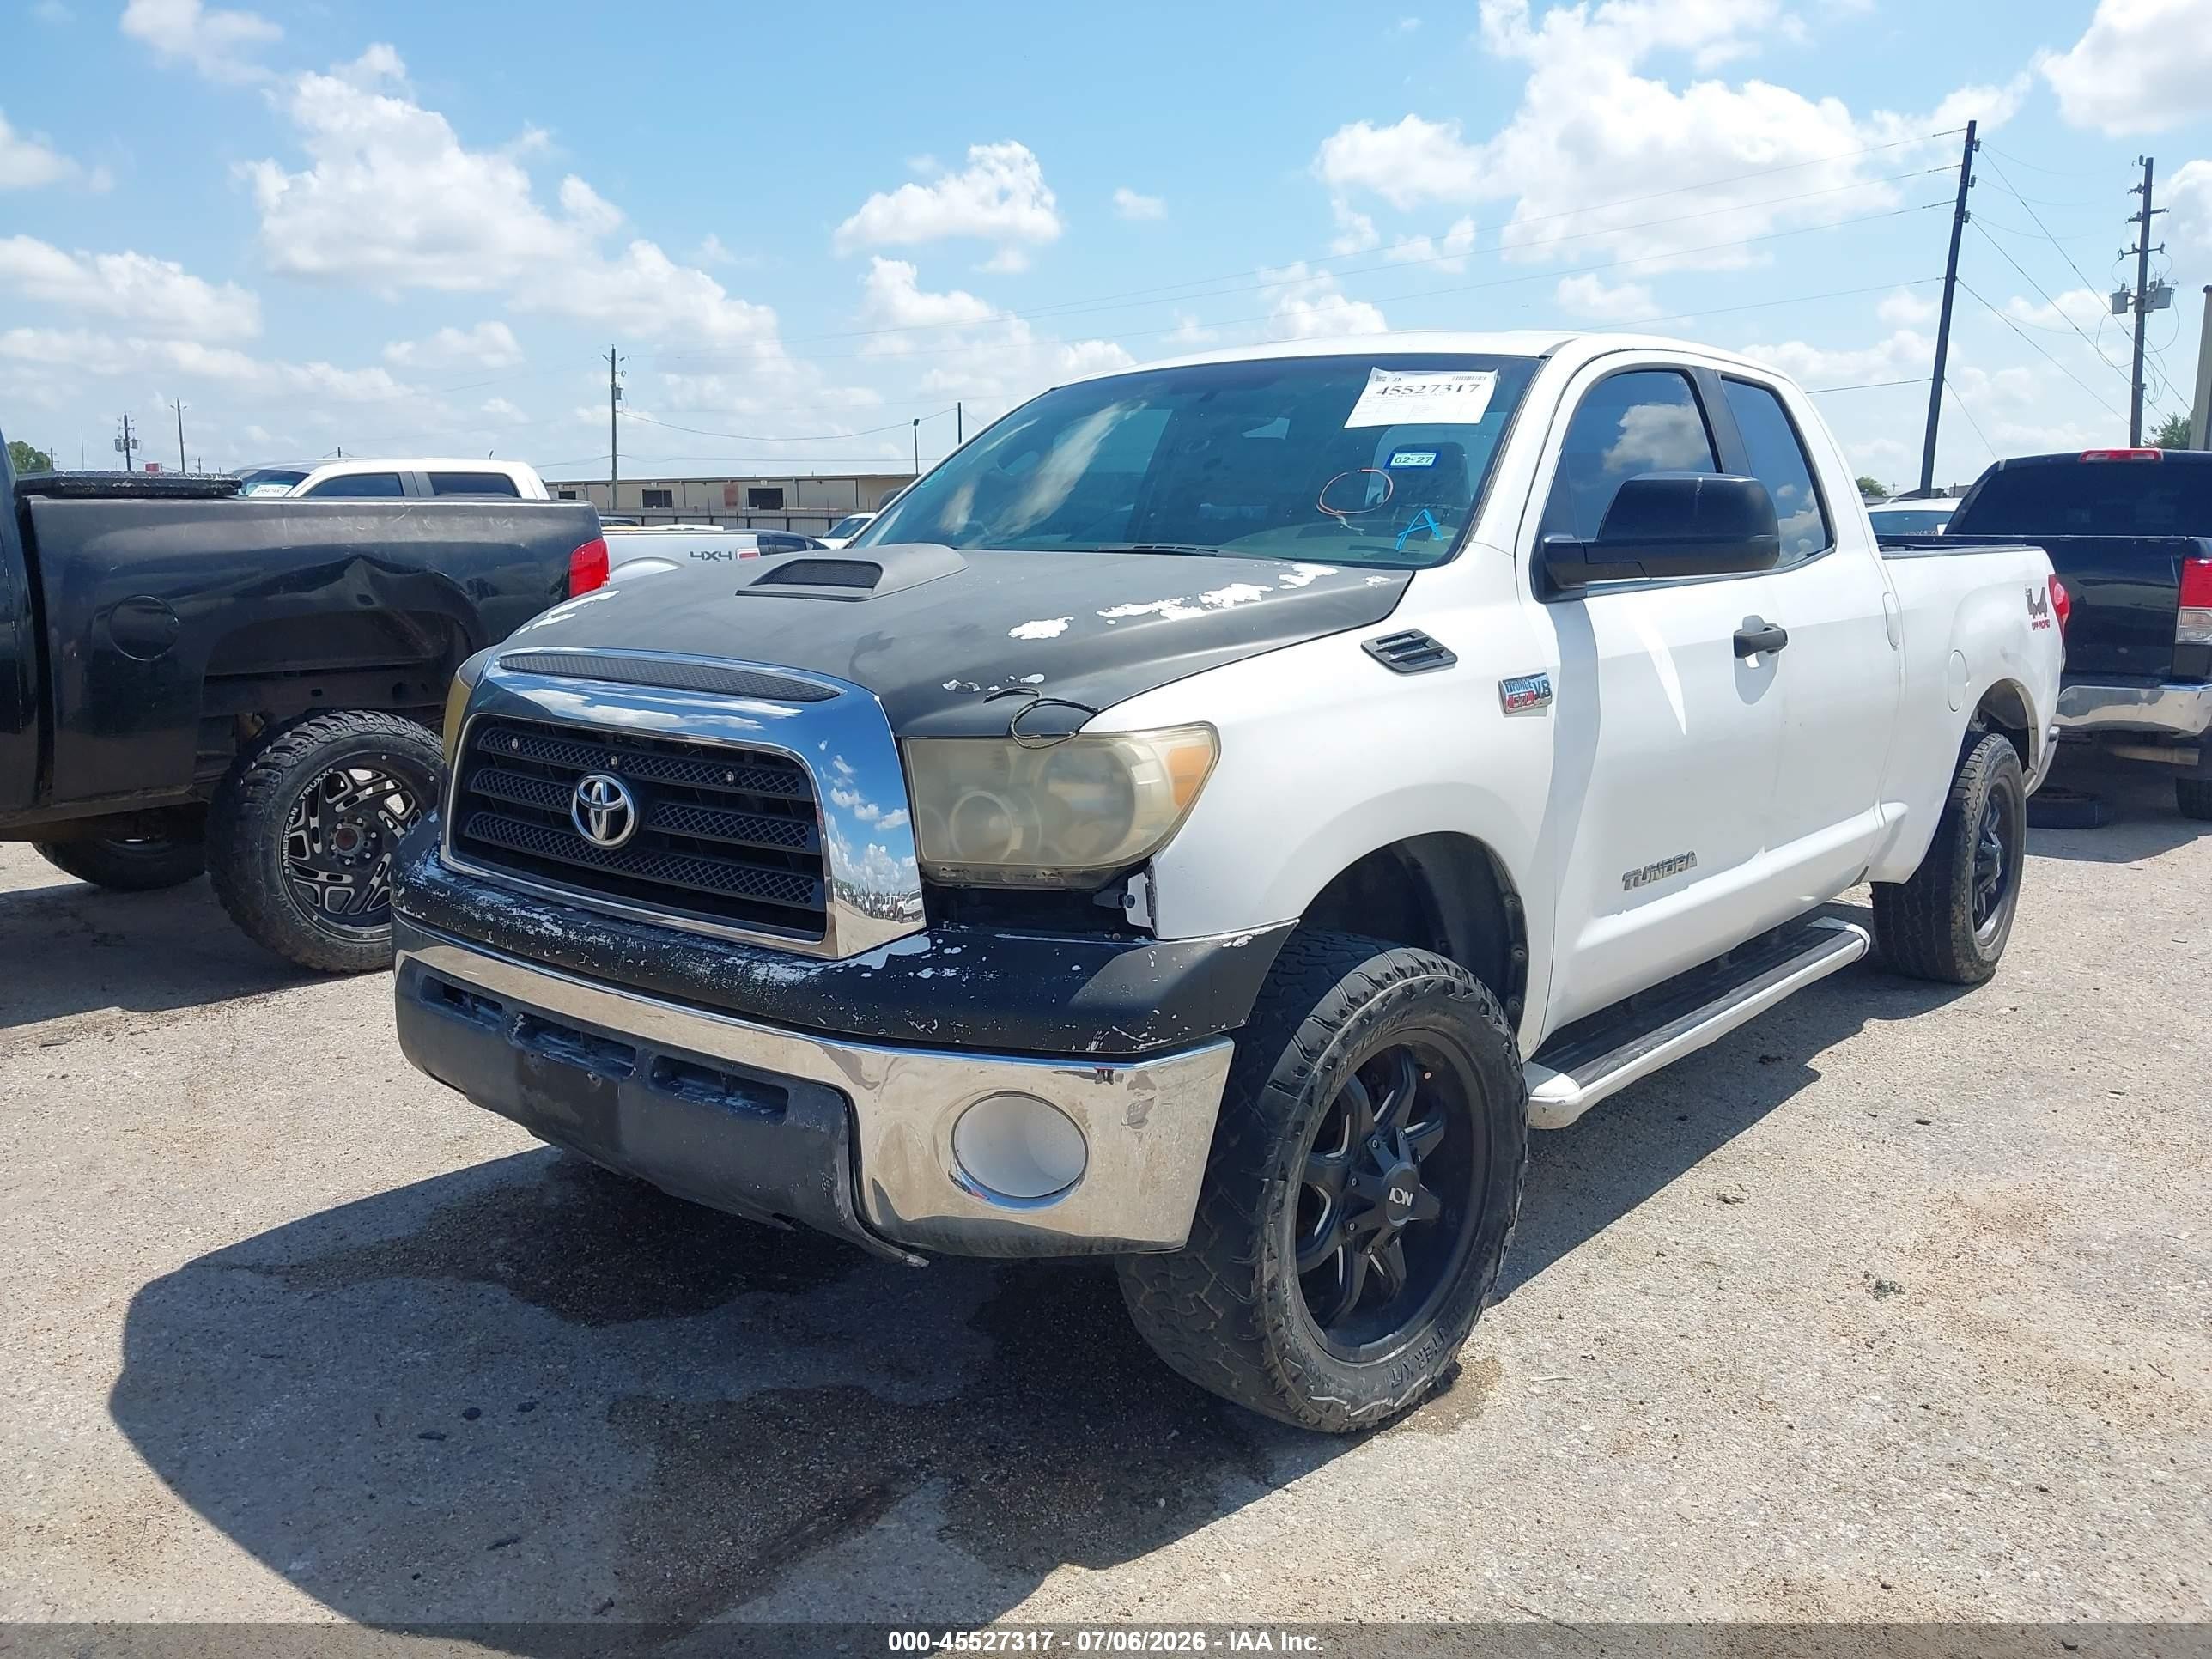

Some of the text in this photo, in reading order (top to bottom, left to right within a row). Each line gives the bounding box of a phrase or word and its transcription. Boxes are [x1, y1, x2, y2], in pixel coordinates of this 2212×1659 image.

[1376, 383, 1480, 396] 45527317
[1395, 508, 1443, 551] A
[282, 771, 330, 867] AMERICAN TRUXX
[1621, 850, 1698, 891] TUNDRA
[1389, 1187, 1414, 1206] ION
